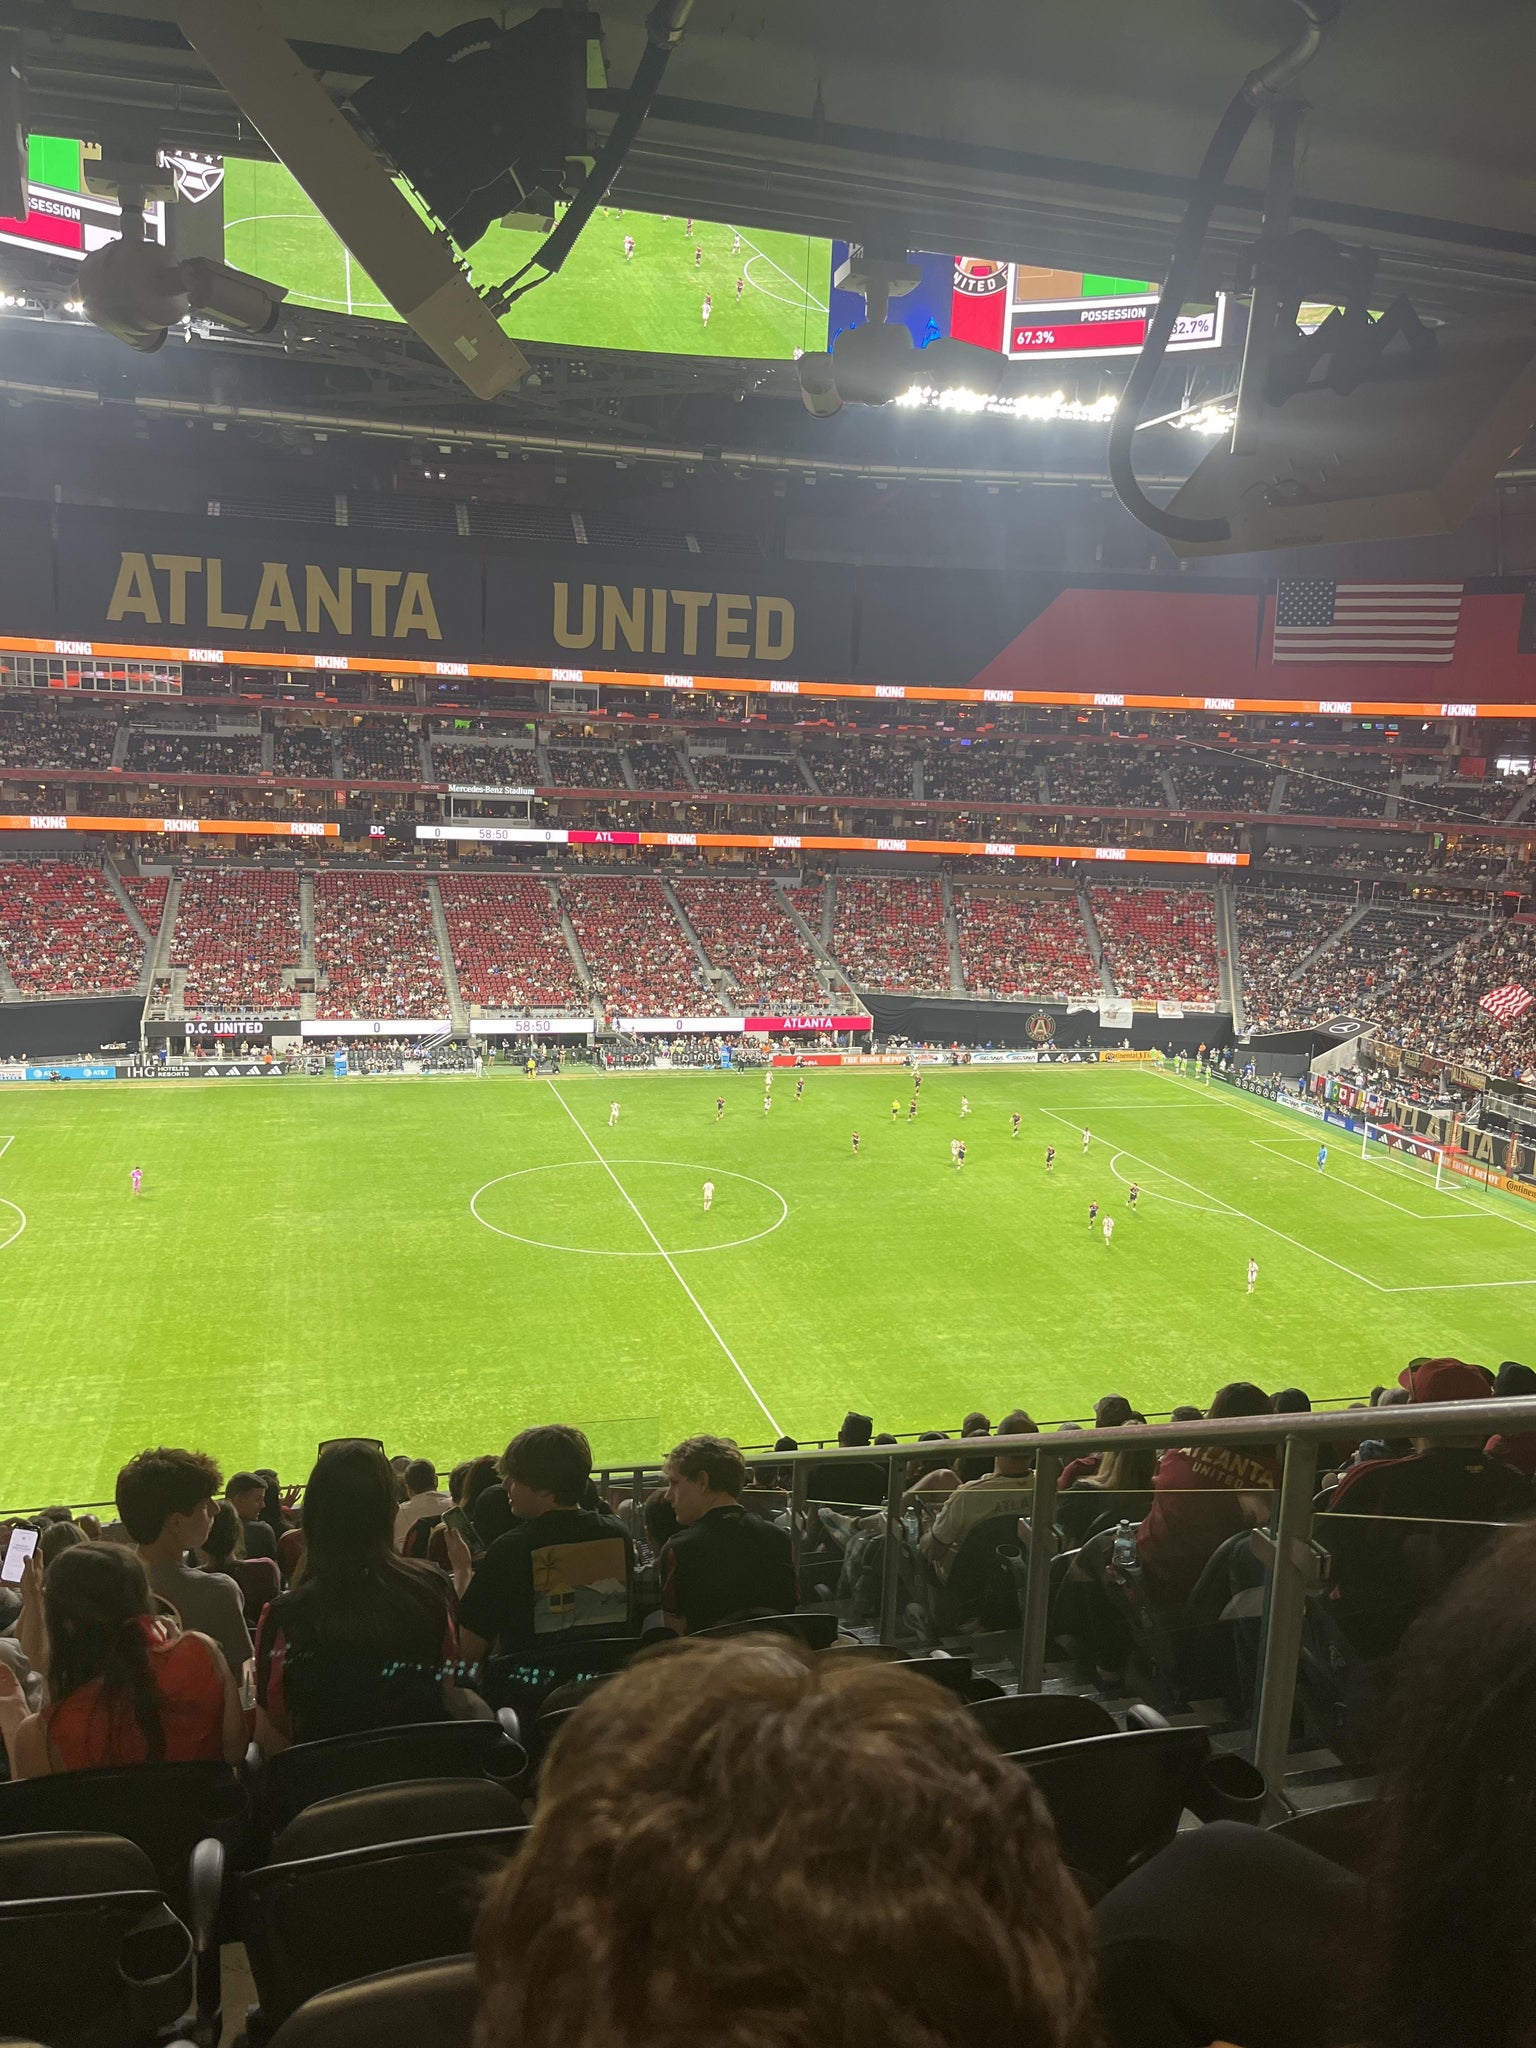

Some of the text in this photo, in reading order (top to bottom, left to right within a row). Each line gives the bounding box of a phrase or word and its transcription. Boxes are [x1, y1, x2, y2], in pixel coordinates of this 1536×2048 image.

[1081, 308, 1146, 322] POSSESSION
[1017, 331, 1055, 344] 67.3%
[106, 552, 795, 660] ATLANTA UNITED
[55, 641, 92, 655] RKING
[189, 649, 223, 662] RKING
[314, 656, 348, 669] RKING
[436, 662, 468, 675] RKING
[552, 669, 583, 681] RKING
[664, 675, 693, 687] RKING
[770, 681, 798, 693] RKING
[875, 686, 904, 697] RKING
[984, 690, 1013, 701] RKING
[1094, 694, 1124, 705] RKING
[1204, 698, 1235, 709] RKING
[1319, 702, 1351, 713] RKING
[448, 784, 504, 794] Mercedes-Benz
[505, 786, 535, 795] Stadium
[30, 816, 66, 828] RKING
[164, 819, 199, 832] RKING
[291, 823, 324, 835] RKING
[370, 825, 385, 835] DC
[434, 828, 441, 838] 0
[479, 829, 508, 839] 58:50
[545, 831, 551, 841] 0
[595, 832, 614, 842] ATL
[667, 833, 696, 845] RKING
[773, 836, 801, 847] RKING
[877, 839, 906, 851] RKING
[985, 844, 1015, 855] RKING
[1096, 848, 1126, 860] RKING
[1206, 853, 1236, 864] RKING
[185, 1022, 263, 1034] D.C. UNITED
[373, 1022, 381, 1033] 0
[515, 1021, 551, 1032] 58:50
[676, 1019, 683, 1031] 0
[783, 1017, 833, 1028] ATLANTA
[882, 1055, 907, 1063] DEPO
[127, 1066, 155, 1077] IHG
[1192, 1461, 1244, 1489] UNITED
